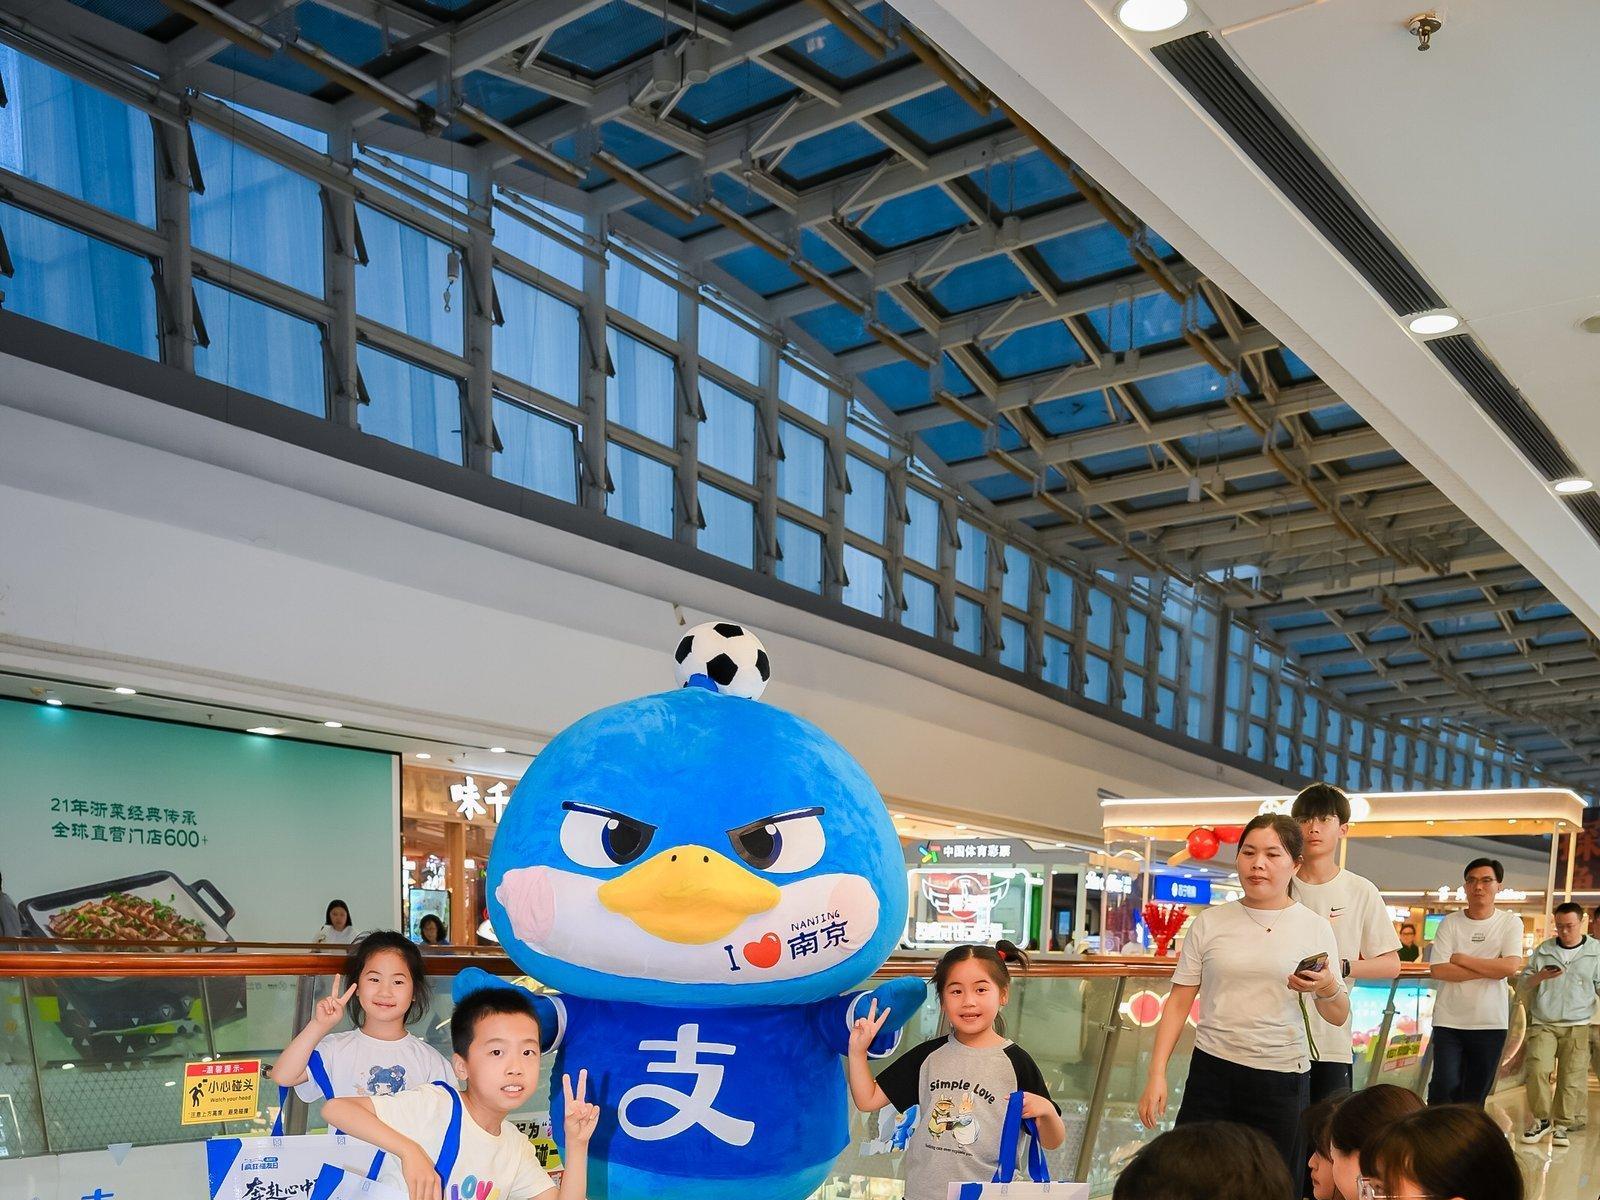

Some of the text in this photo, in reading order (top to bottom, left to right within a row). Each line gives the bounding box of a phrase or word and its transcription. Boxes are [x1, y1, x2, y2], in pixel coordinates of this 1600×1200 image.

[50, 797, 198, 826] 21年浙菜经典传承
[51, 821, 209, 848] 全球直营门店600+
[943, 844, 1011, 858] 中国体育彩票
[791, 909, 840, 931] NANJING
[787, 920, 850, 960] 南京
[208, 1078, 254, 1094] 小心碰头
[973, 1083, 996, 1105] Love
